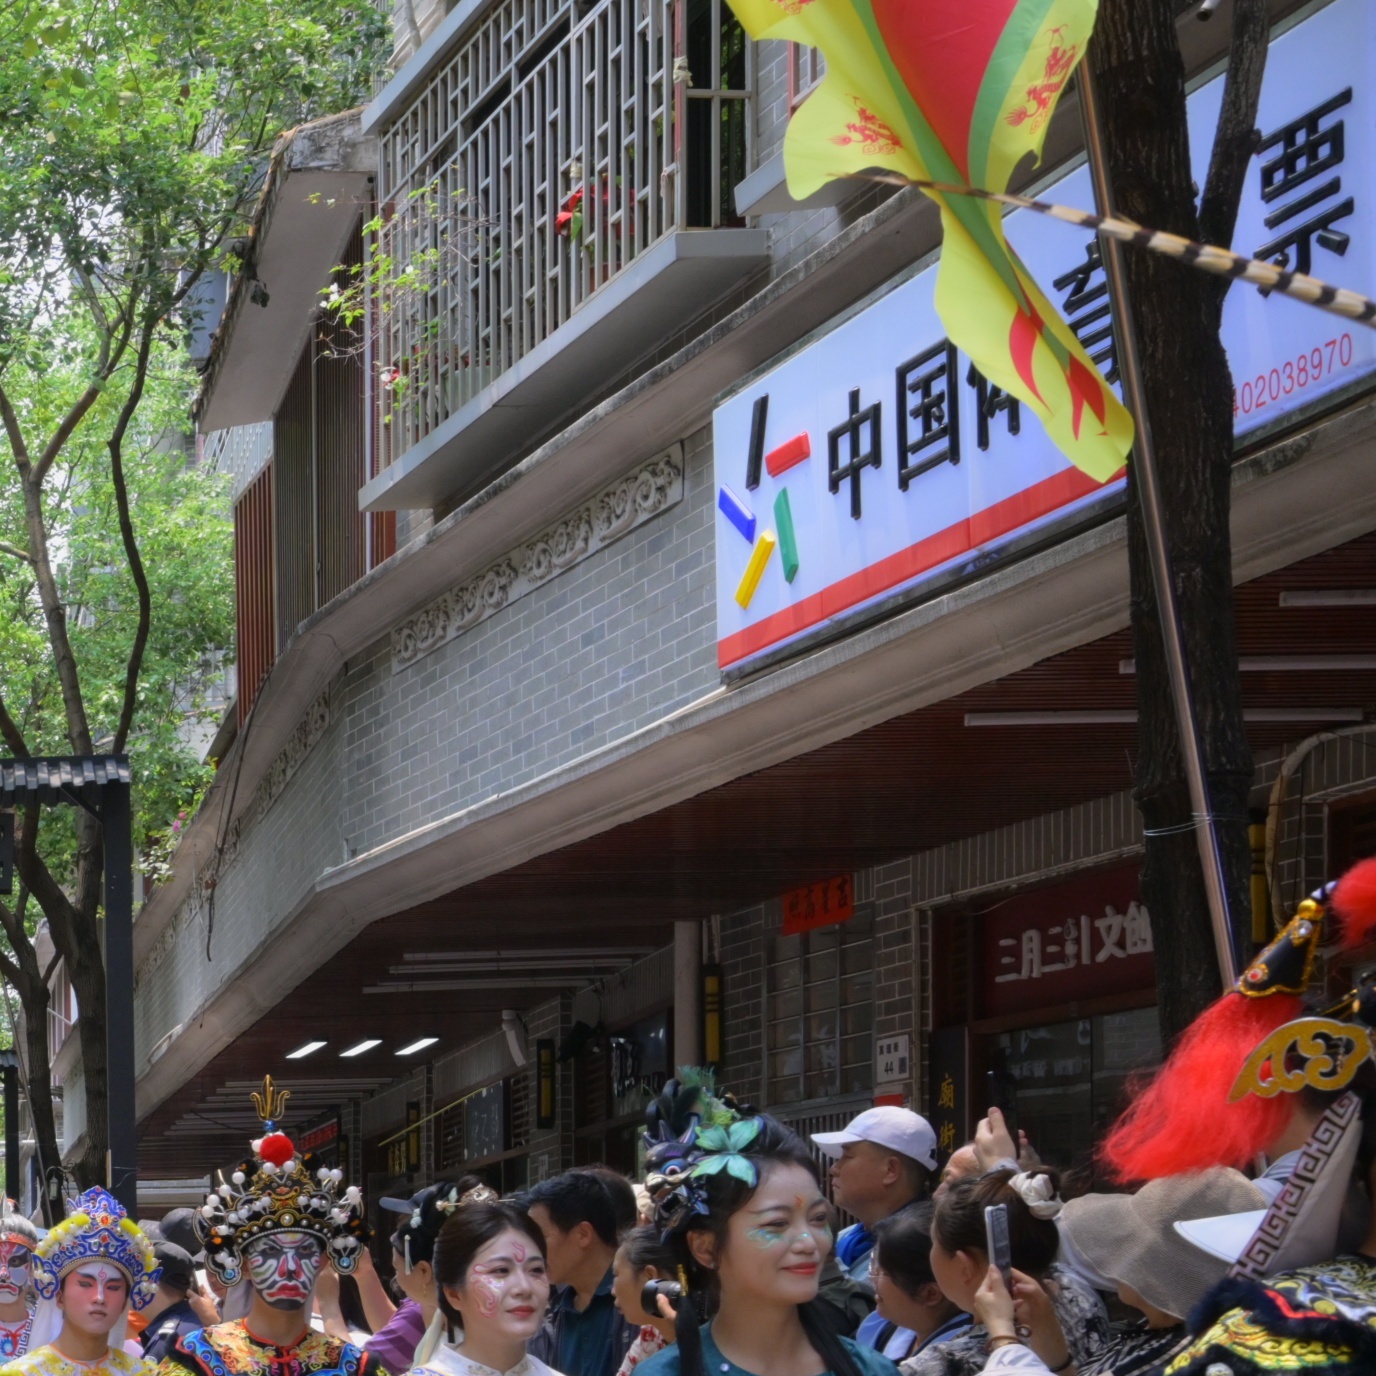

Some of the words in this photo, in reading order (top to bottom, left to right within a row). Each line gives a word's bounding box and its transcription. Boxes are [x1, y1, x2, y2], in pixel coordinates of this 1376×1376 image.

[827, 86, 1355, 520] 中国育票
[884, 1061, 894, 1076] 44
